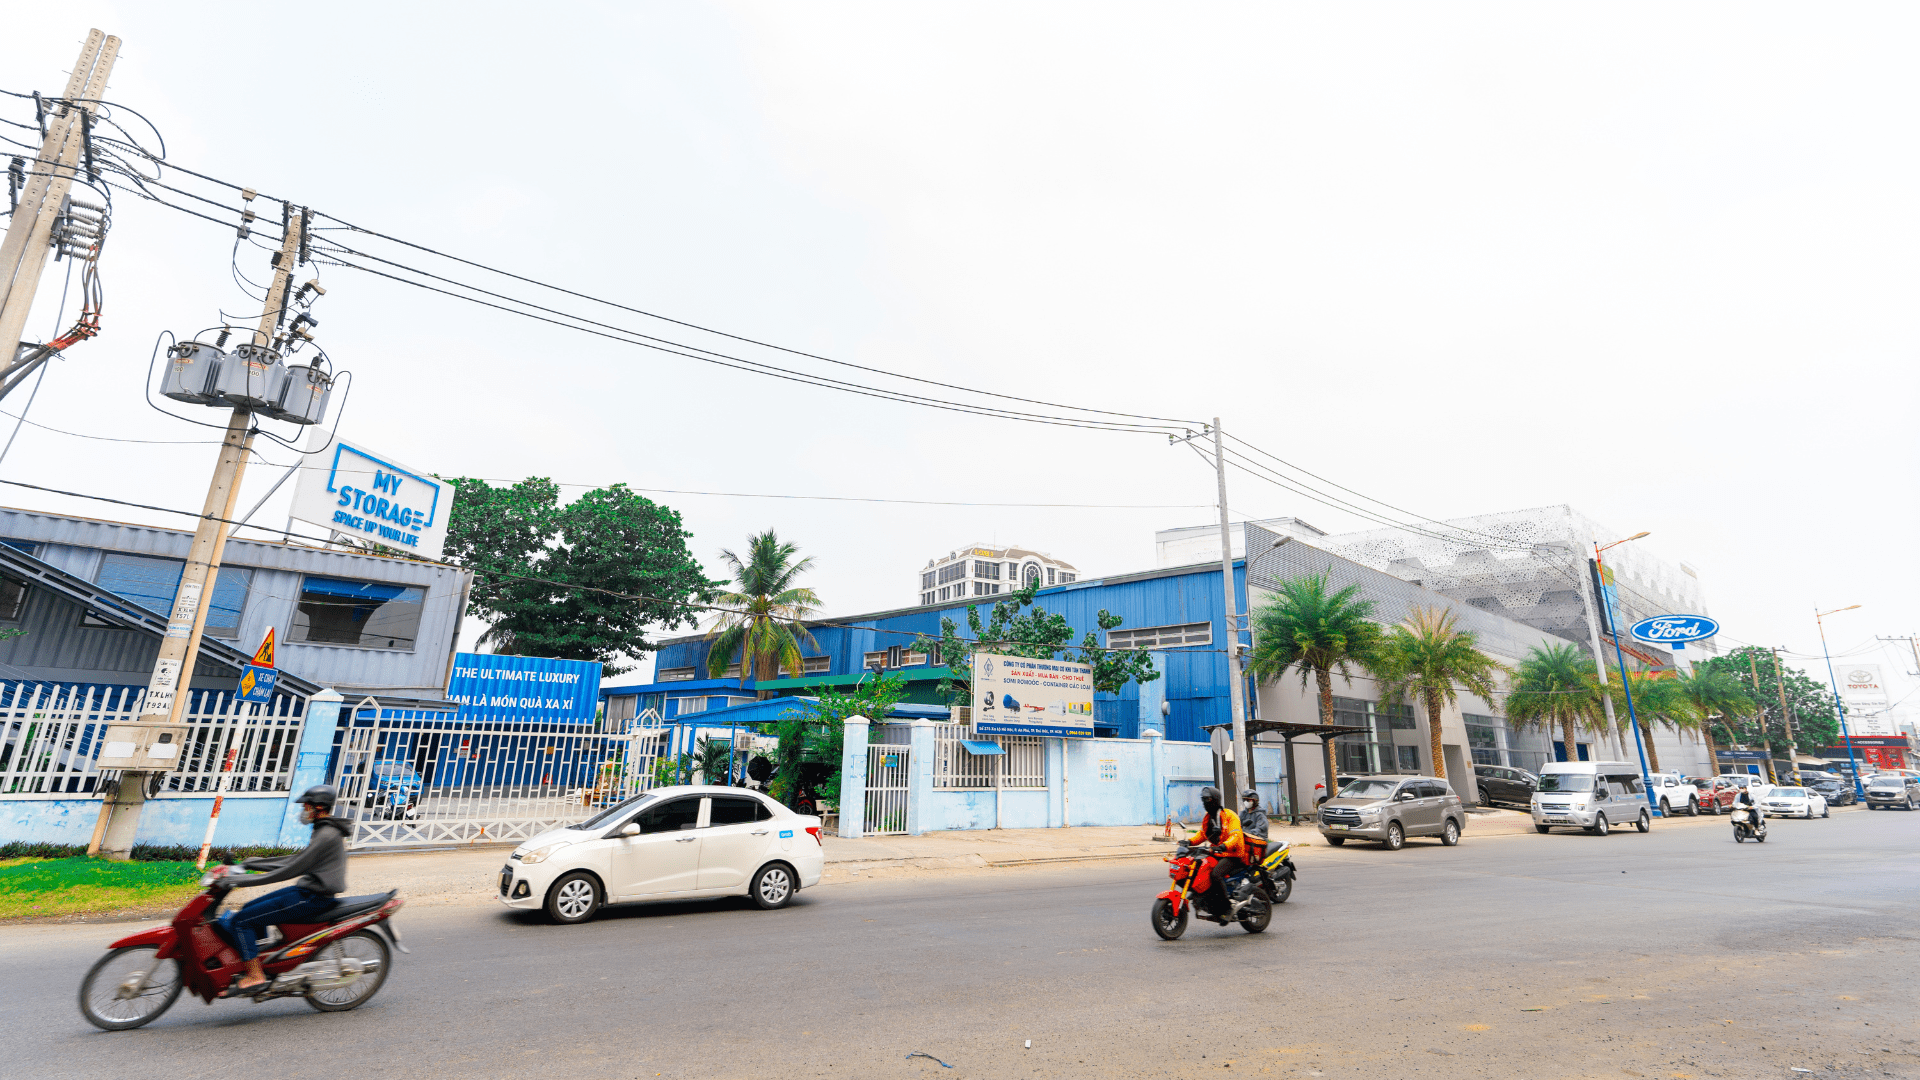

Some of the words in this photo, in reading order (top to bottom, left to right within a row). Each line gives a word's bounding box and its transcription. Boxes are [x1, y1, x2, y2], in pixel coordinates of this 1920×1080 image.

[373, 469, 403, 496] MY
[338, 485, 424, 531] STORAGE
[333, 510, 364, 530] SPACE
[364, 520, 378, 533] UP
[378, 524, 402, 542] YOUR
[401, 531, 419, 548] LIFE
[1648, 619, 1700, 639] Ford
[455, 667, 478, 679] THE
[480, 668, 538, 682] ULTIMATE
[539, 672, 580, 684] LUXURY
[446, 694, 471, 706] IAN
[472, 693, 487, 706] LÀ
[490, 694, 518, 707] MÓN
[520, 695, 542, 709] QUÀ
[545, 698, 559, 709] XA
